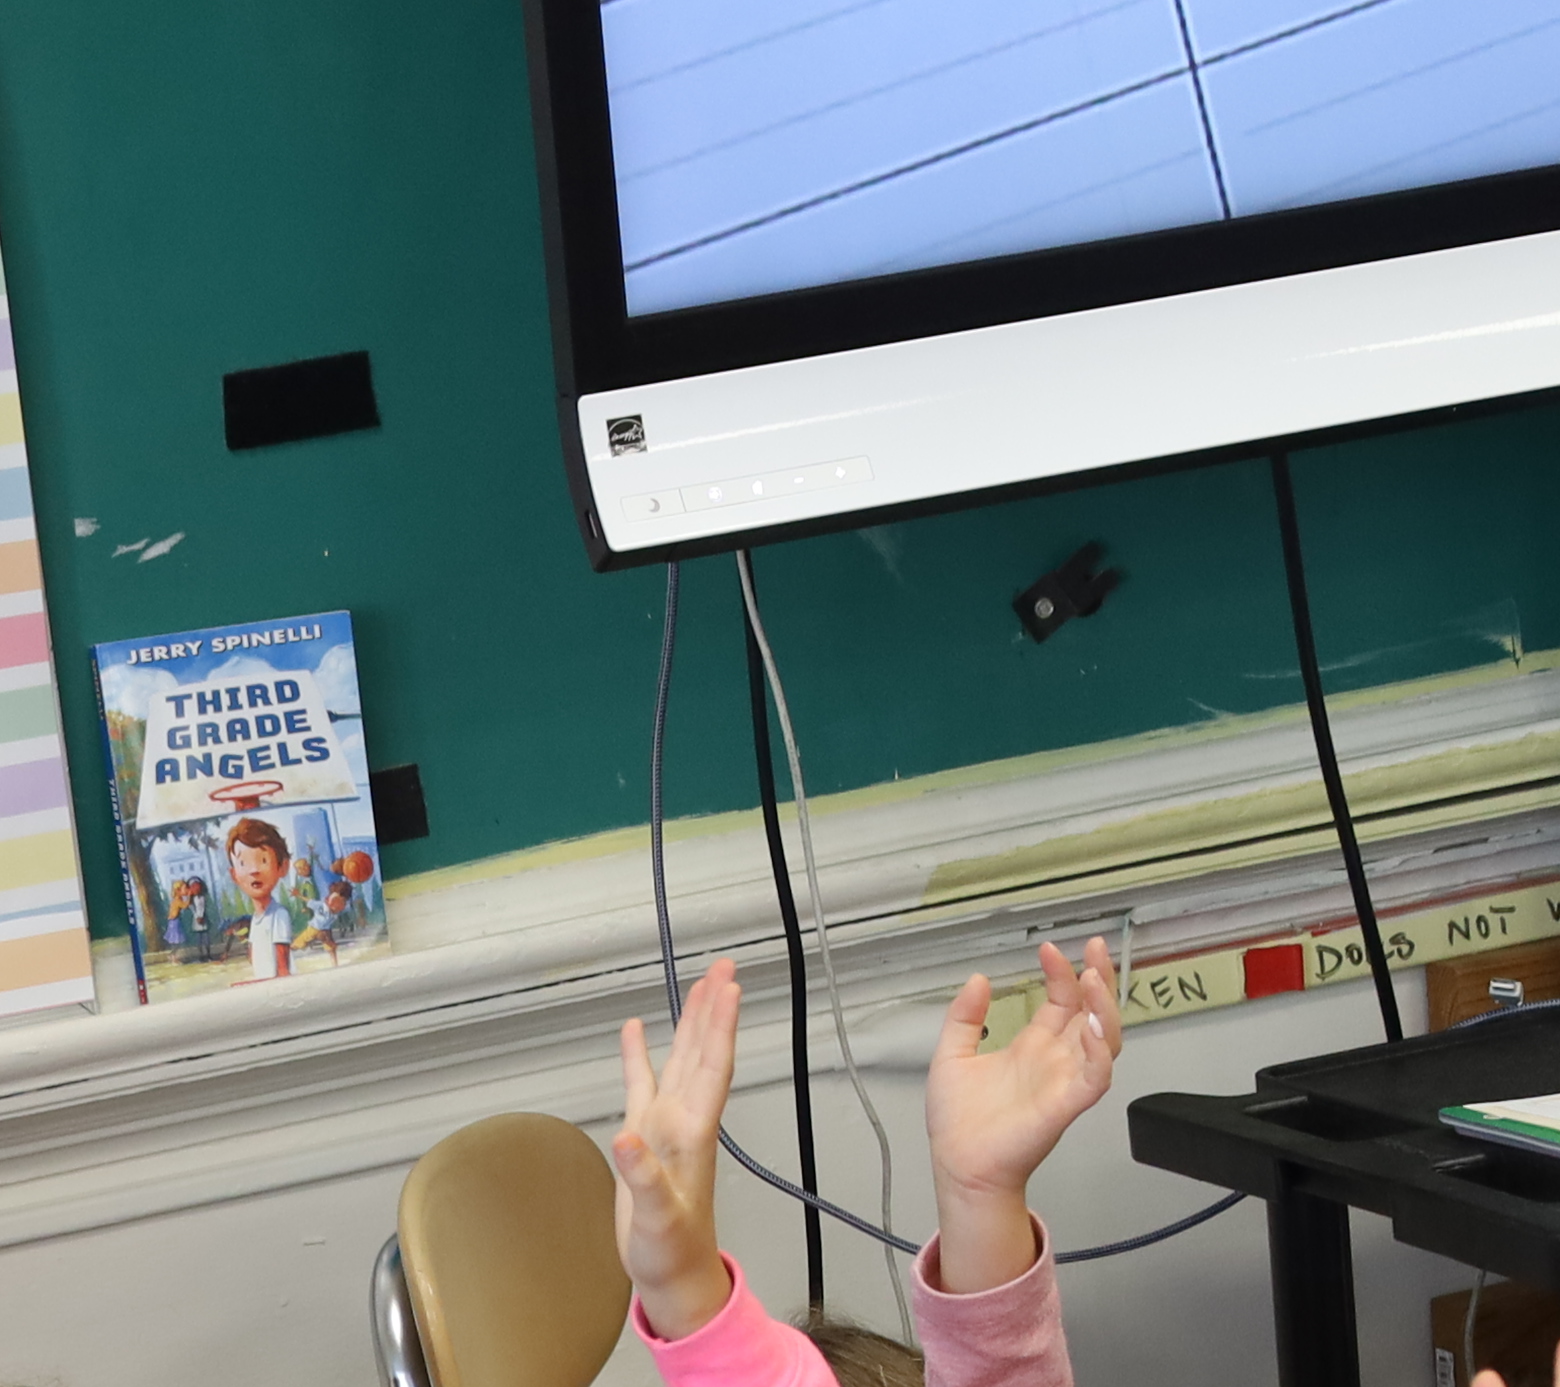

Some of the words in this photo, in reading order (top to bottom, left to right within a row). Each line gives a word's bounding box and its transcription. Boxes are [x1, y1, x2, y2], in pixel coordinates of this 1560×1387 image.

[125, 640, 204, 667] JERRY
[211, 623, 323, 653] SPINELLI
[165, 679, 301, 720] THIRD
[166, 708, 312, 750] GRADE
[155, 736, 331, 786] ANGELS
[1118, 971, 1209, 1010] KEN
[1446, 904, 1517, 945] NOT
